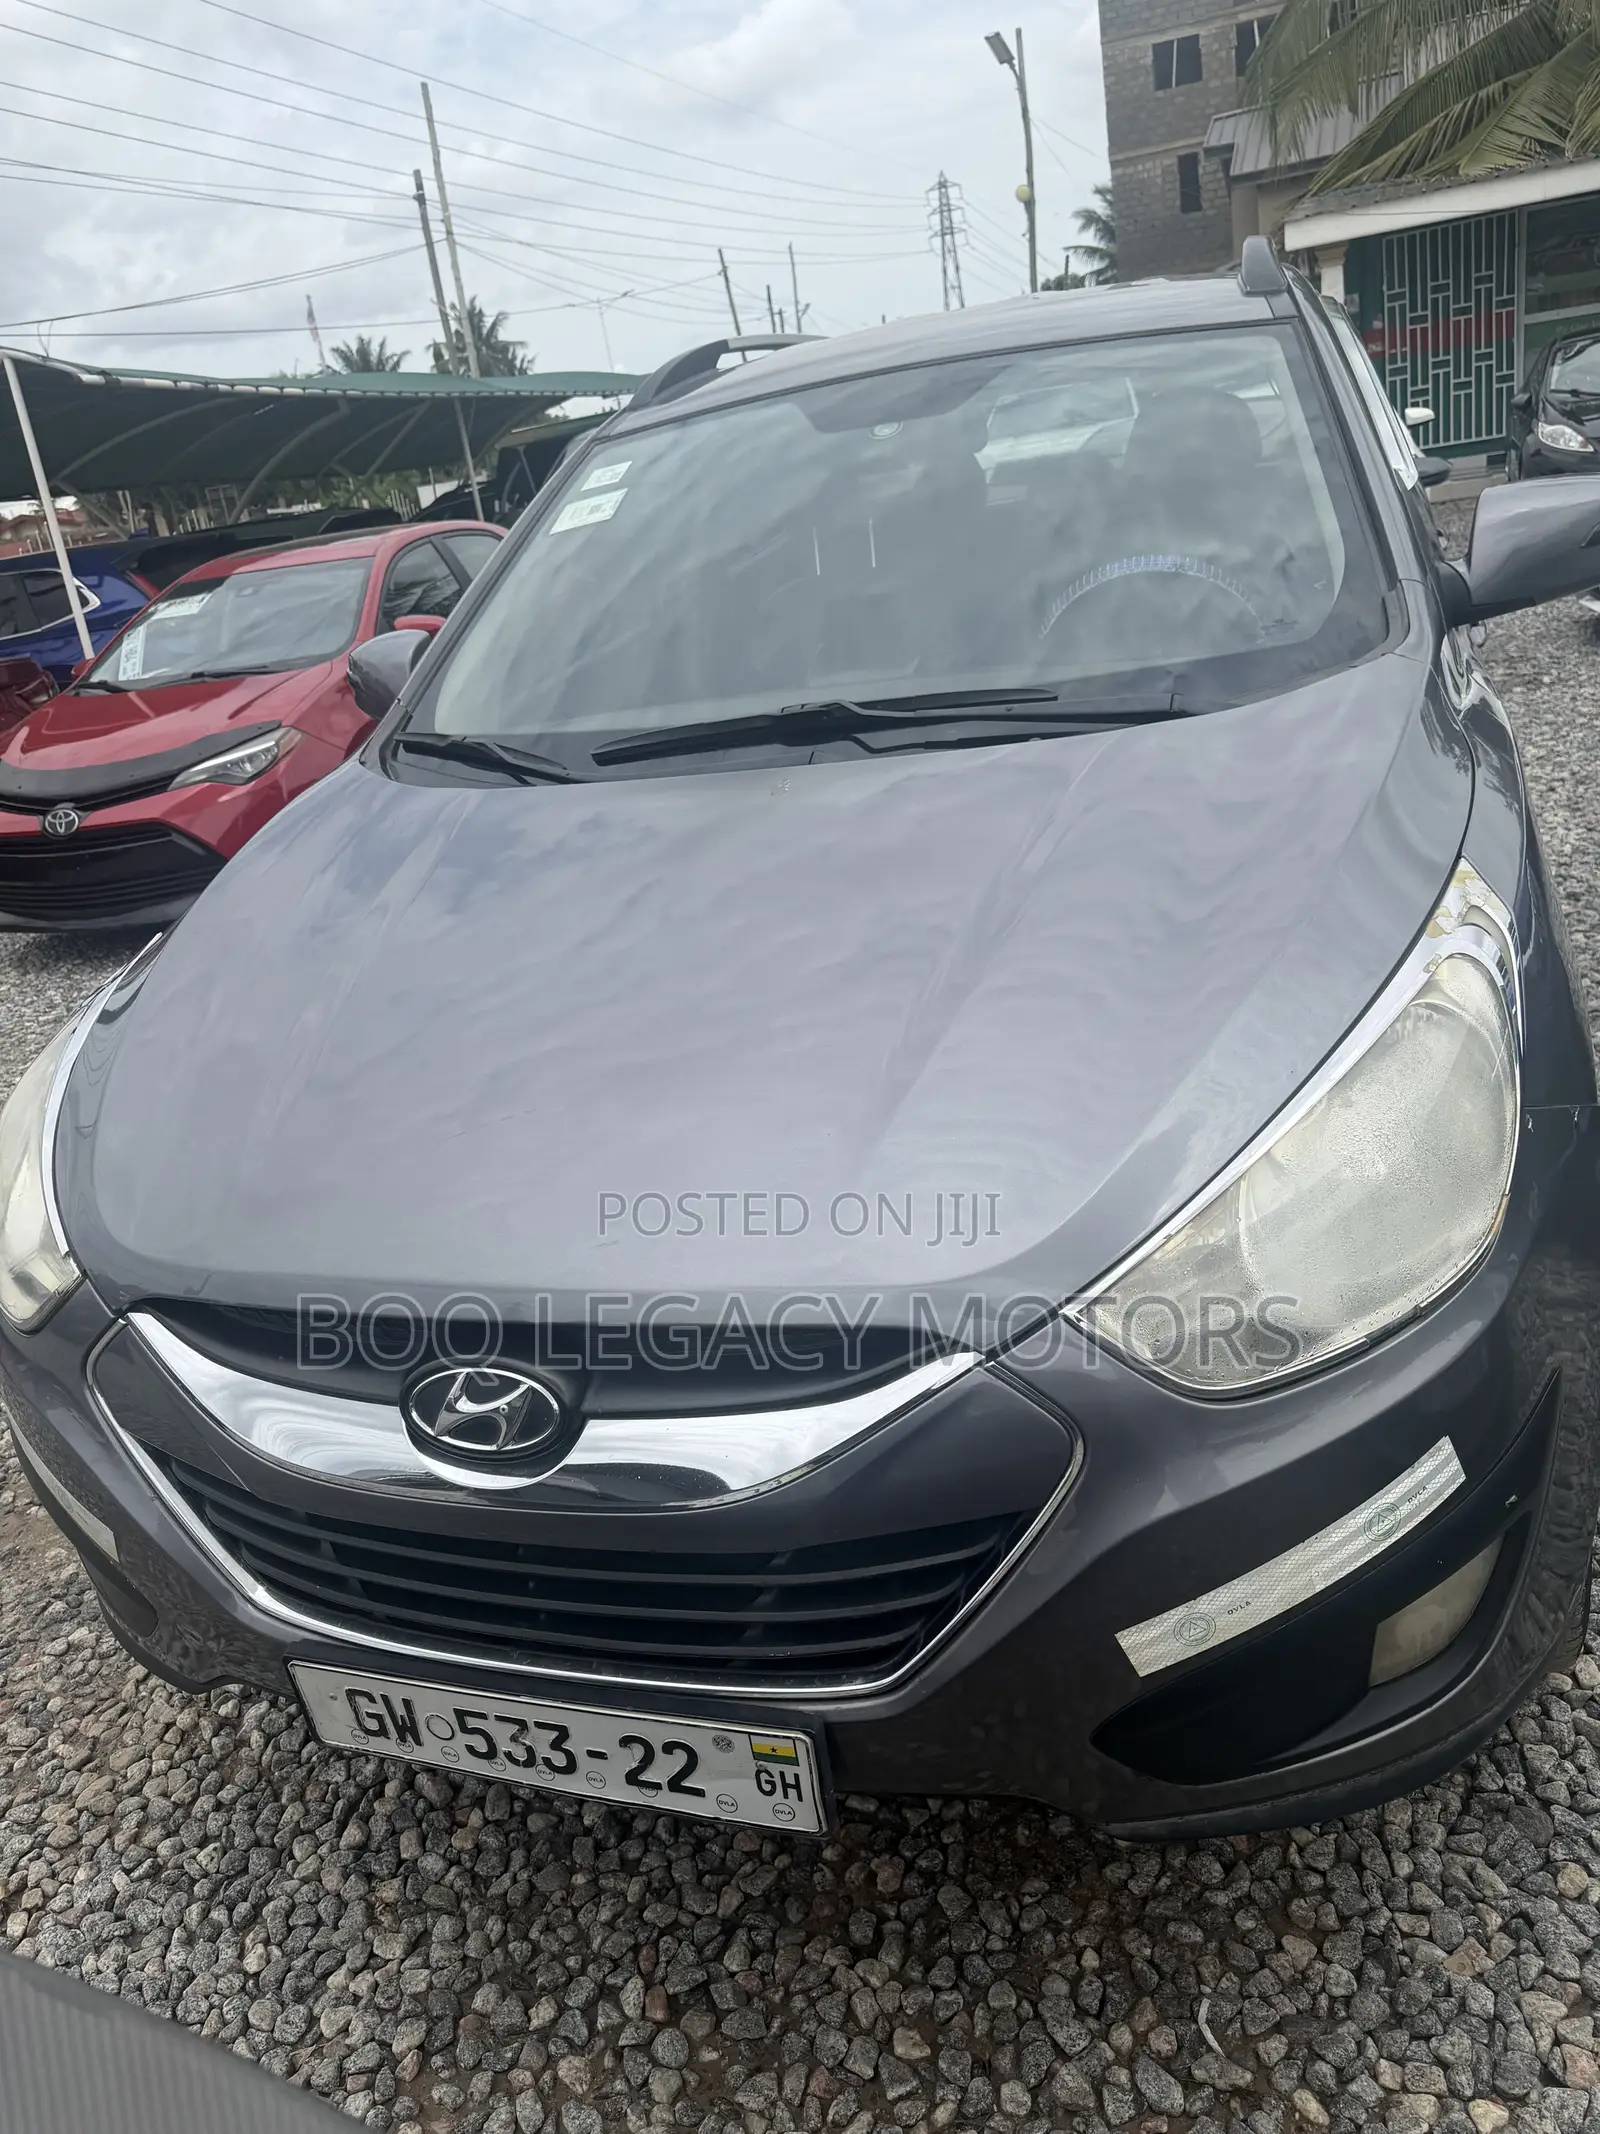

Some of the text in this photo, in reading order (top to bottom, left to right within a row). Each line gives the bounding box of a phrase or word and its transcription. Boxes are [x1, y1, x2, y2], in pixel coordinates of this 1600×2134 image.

[344, 1687, 706, 1798] GW 533-22
[754, 1767, 803, 1803] GH
[718, 1799, 736, 1808] DVLA
[774, 1808, 792, 1816] DVLA
